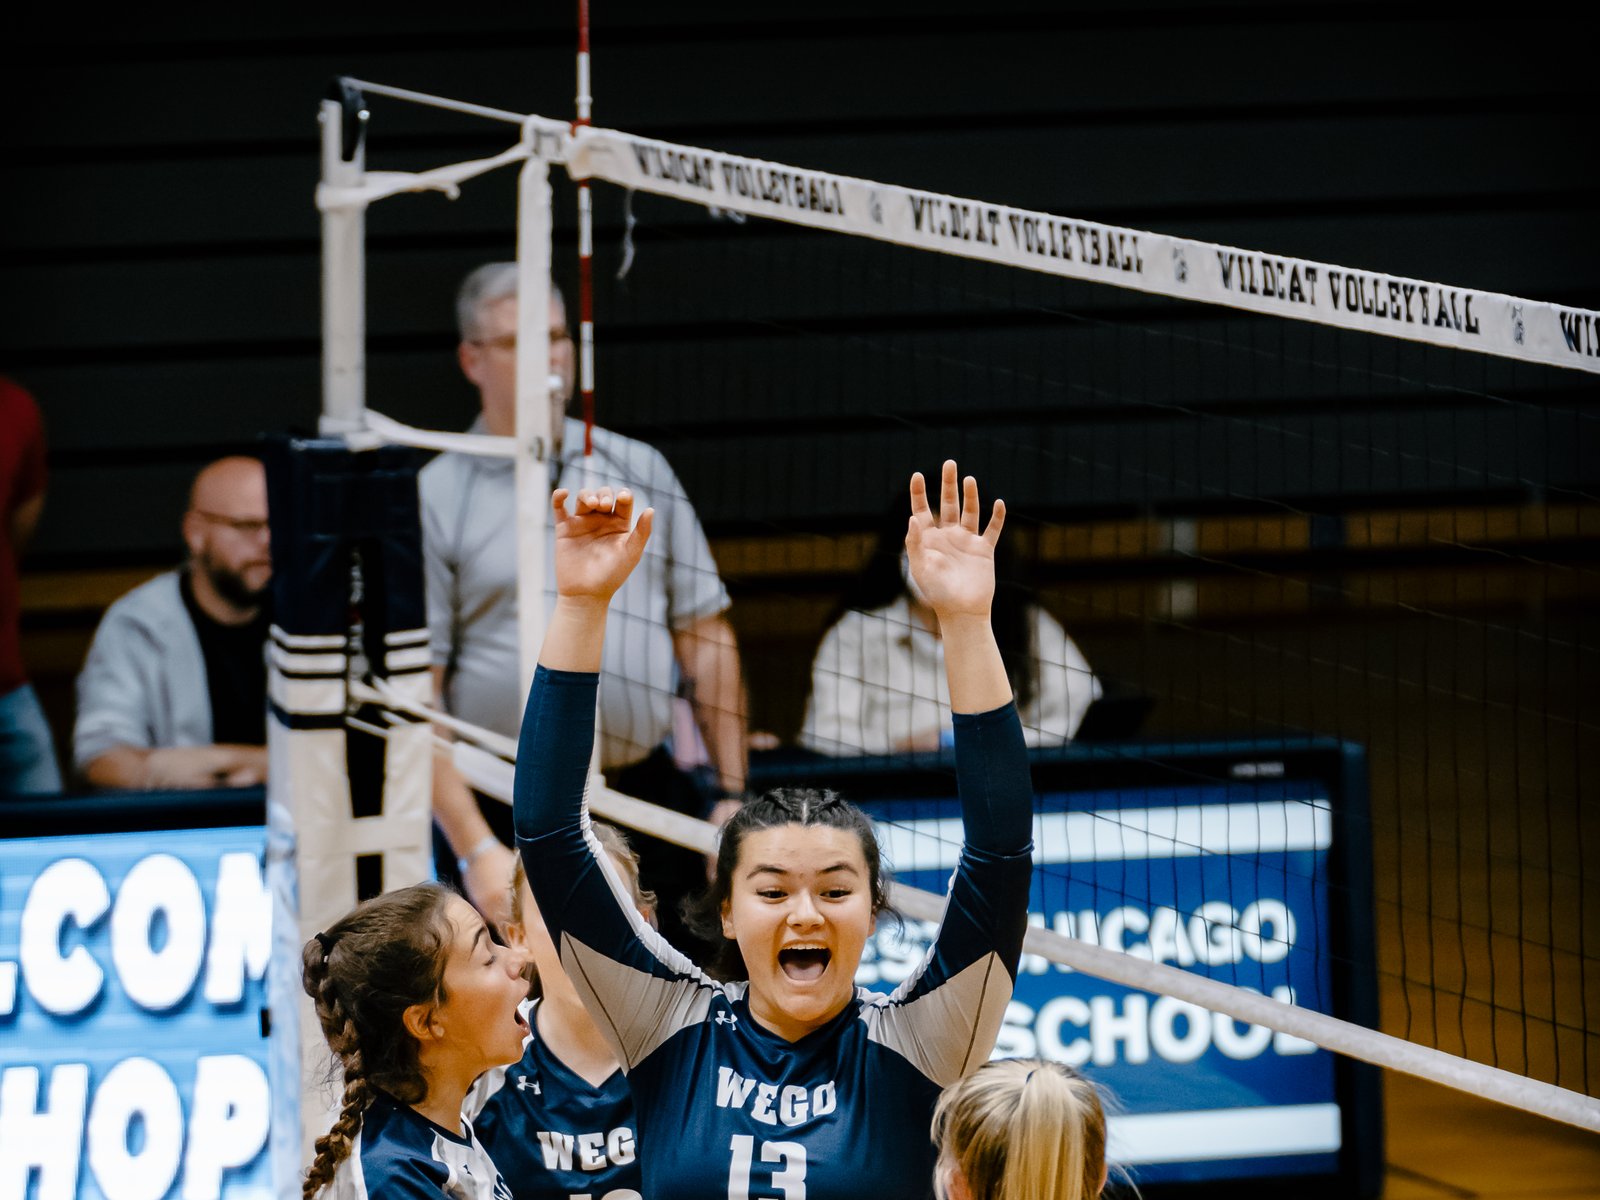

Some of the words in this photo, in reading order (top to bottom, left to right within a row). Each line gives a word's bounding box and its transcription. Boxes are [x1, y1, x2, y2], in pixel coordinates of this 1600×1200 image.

[1217, 251, 1317, 306] WILDCAT
[0, 852, 272, 1016] COM
[1020, 899, 1297, 976] HICAGO
[716, 1066, 837, 1126] WEGO
